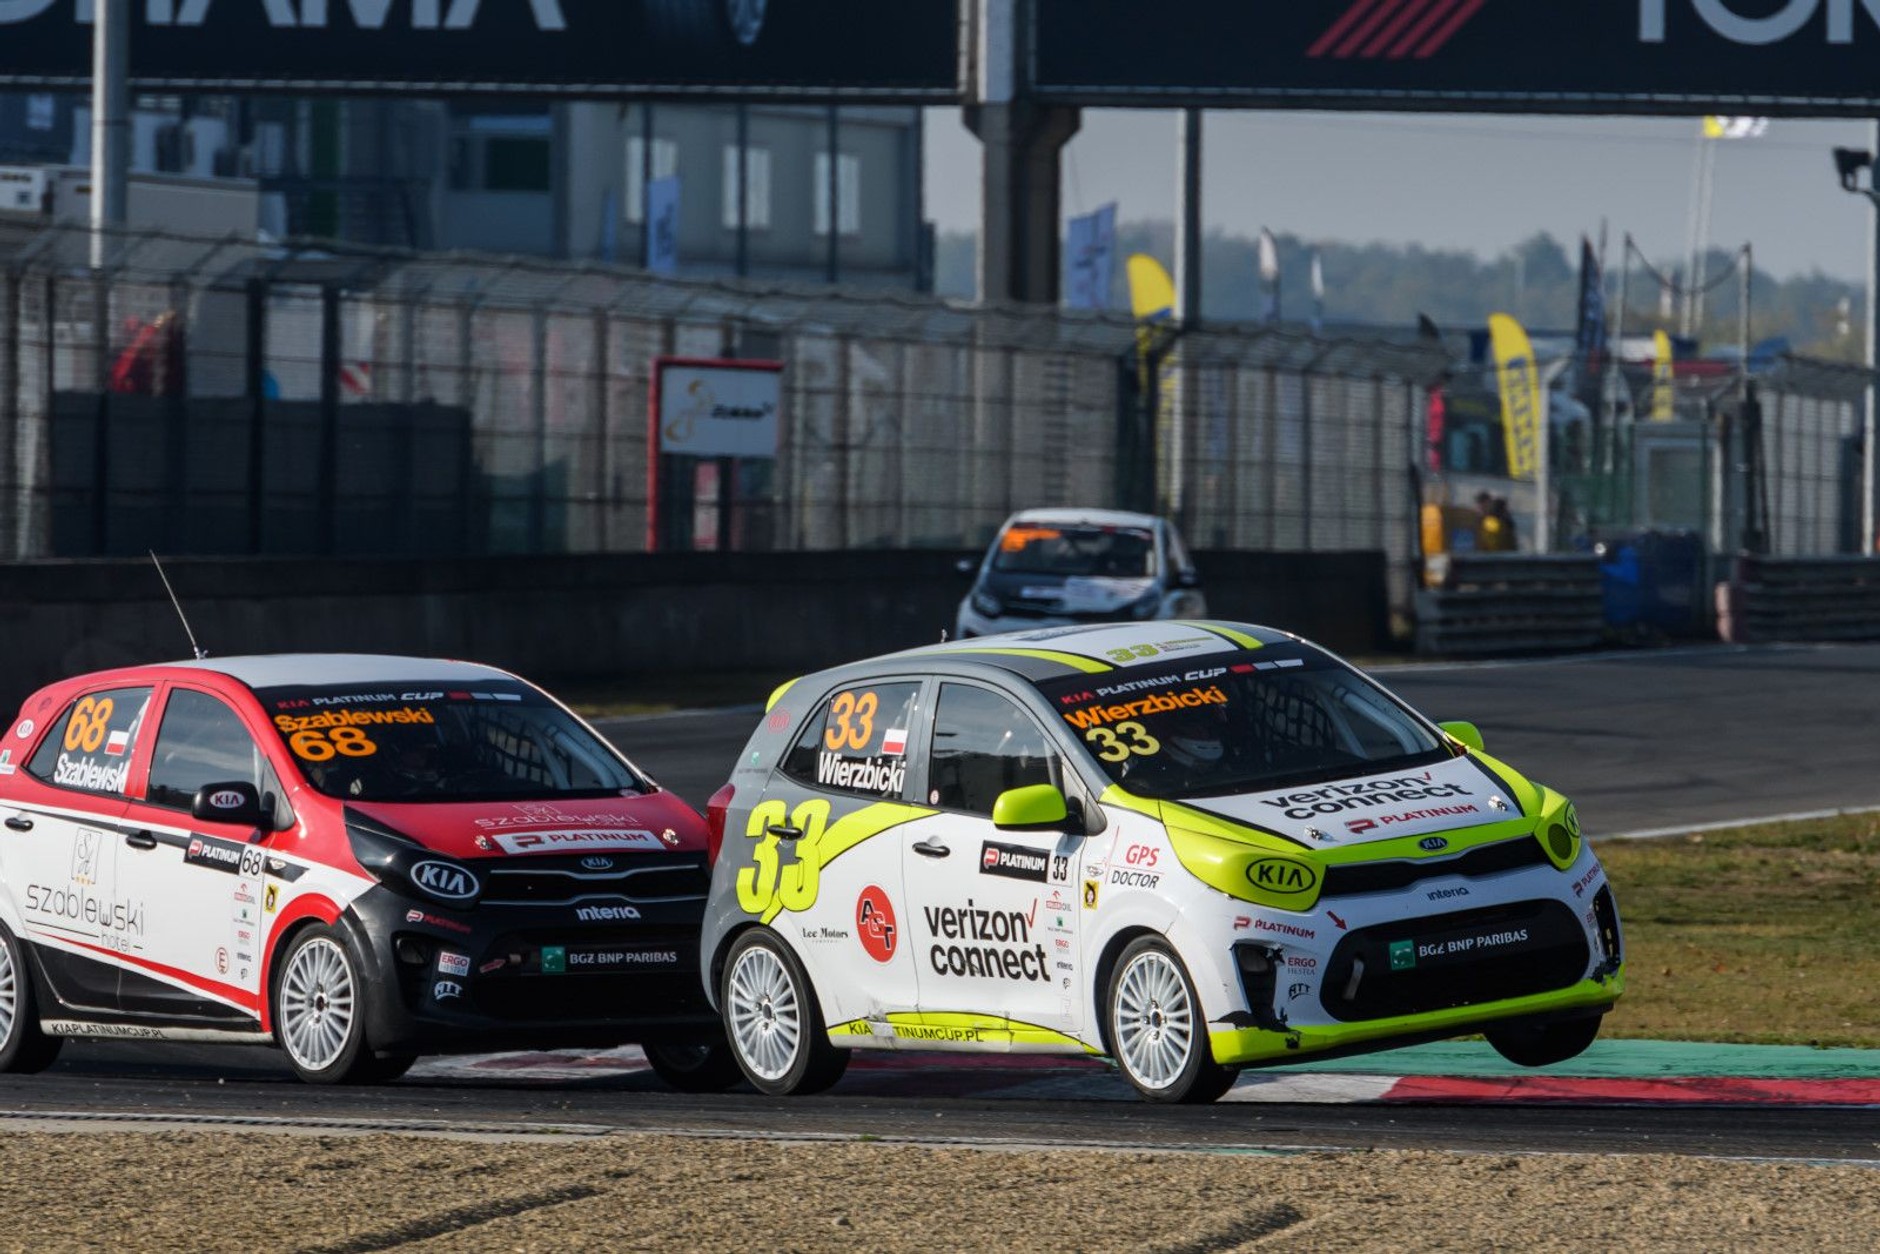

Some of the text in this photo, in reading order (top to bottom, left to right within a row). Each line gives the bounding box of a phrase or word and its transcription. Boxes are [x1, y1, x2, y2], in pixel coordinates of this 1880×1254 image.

[1105, 643, 1158, 662] 33
[1060, 667, 1227, 705] KIA PLATINUM CUP
[277, 692, 444, 709] KIA PLATINUM CUP
[1064, 685, 1229, 729] Wierzbicki
[64, 697, 114, 752] 68
[274, 707, 435, 732] Szablewski
[825, 692, 878, 750] 33
[290, 727, 377, 762] 68
[1085, 721, 1161, 762] 33
[818, 752, 906, 793] Wierzbicki
[214, 794, 241, 806] KIA
[1261, 775, 1426, 810] verizon
[1284, 783, 1474, 821] connect
[474, 814, 638, 827] szablewski
[1380, 804, 1478, 826] PLATINUM
[548, 833, 649, 842] PLATINUM
[1422, 838, 1446, 849] KIA
[202, 843, 241, 865] PLATINUM
[242, 849, 262, 875] 68
[586, 857, 609, 866] KIA
[736, 799, 831, 914] 33
[1000, 852, 1046, 871] PLATINUM
[1052, 855, 1068, 881] 33
[1126, 844, 1160, 867] GPS
[421, 864, 465, 894] KIA
[1112, 870, 1159, 889] DOCTOR
[1257, 865, 1305, 887] KIA
[25, 883, 144, 936] szablewski
[576, 906, 641, 920] interia
[924, 898, 1028, 943] verizon
[803, 928, 849, 938] Lee Motors
[1255, 919, 1316, 940] PLATINUM
[1448, 938, 1474, 952] BNP
[1476, 929, 1528, 948] PARIBAS
[441, 954, 468, 967] ERGO
[598, 953, 623, 963] BNP
[626, 952, 677, 963] PARIBAS
[930, 943, 1051, 982] connect
[1287, 957, 1317, 968] ERGO
[1288, 983, 1312, 1000] ATT
[51, 1023, 169, 1039] KIAPLATINUMCUP.PL
[849, 1023, 985, 1043] KIATINUMCUP.PL
